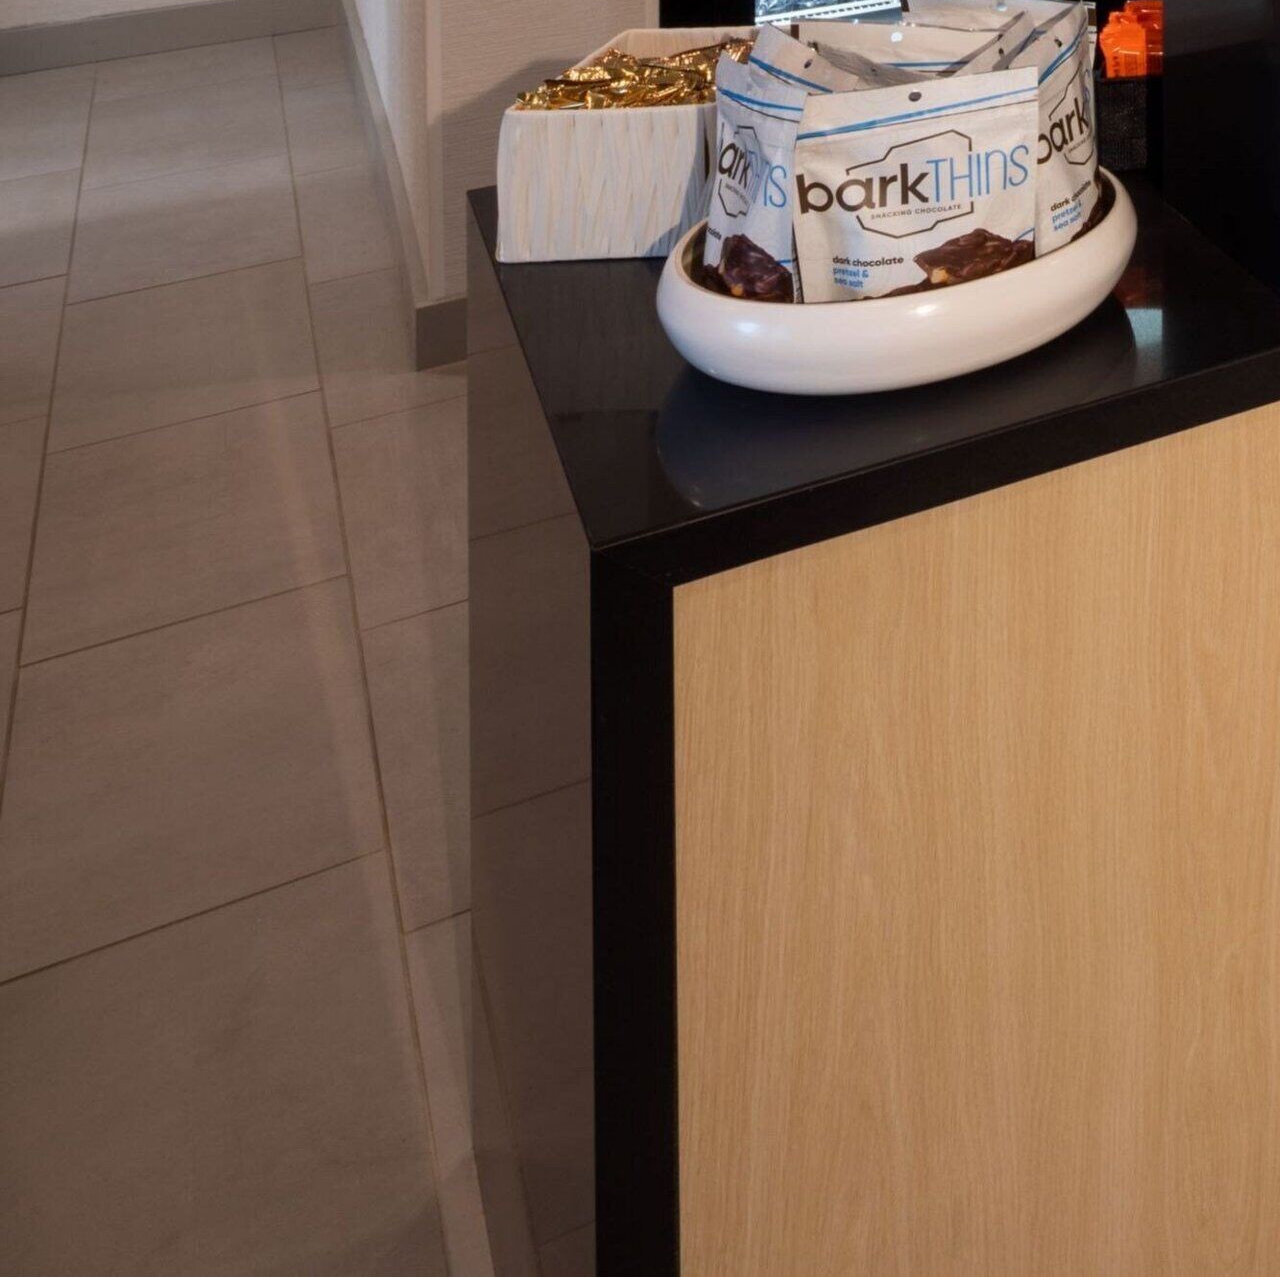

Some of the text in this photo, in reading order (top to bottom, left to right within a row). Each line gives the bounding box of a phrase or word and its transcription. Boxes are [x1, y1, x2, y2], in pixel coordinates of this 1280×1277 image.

[796, 144, 1029, 215] barkTHINS
[914, 203, 963, 215] CHOCOLATE
[1050, 197, 1070, 212] dark
[832, 255, 904, 267] dark chocolate
